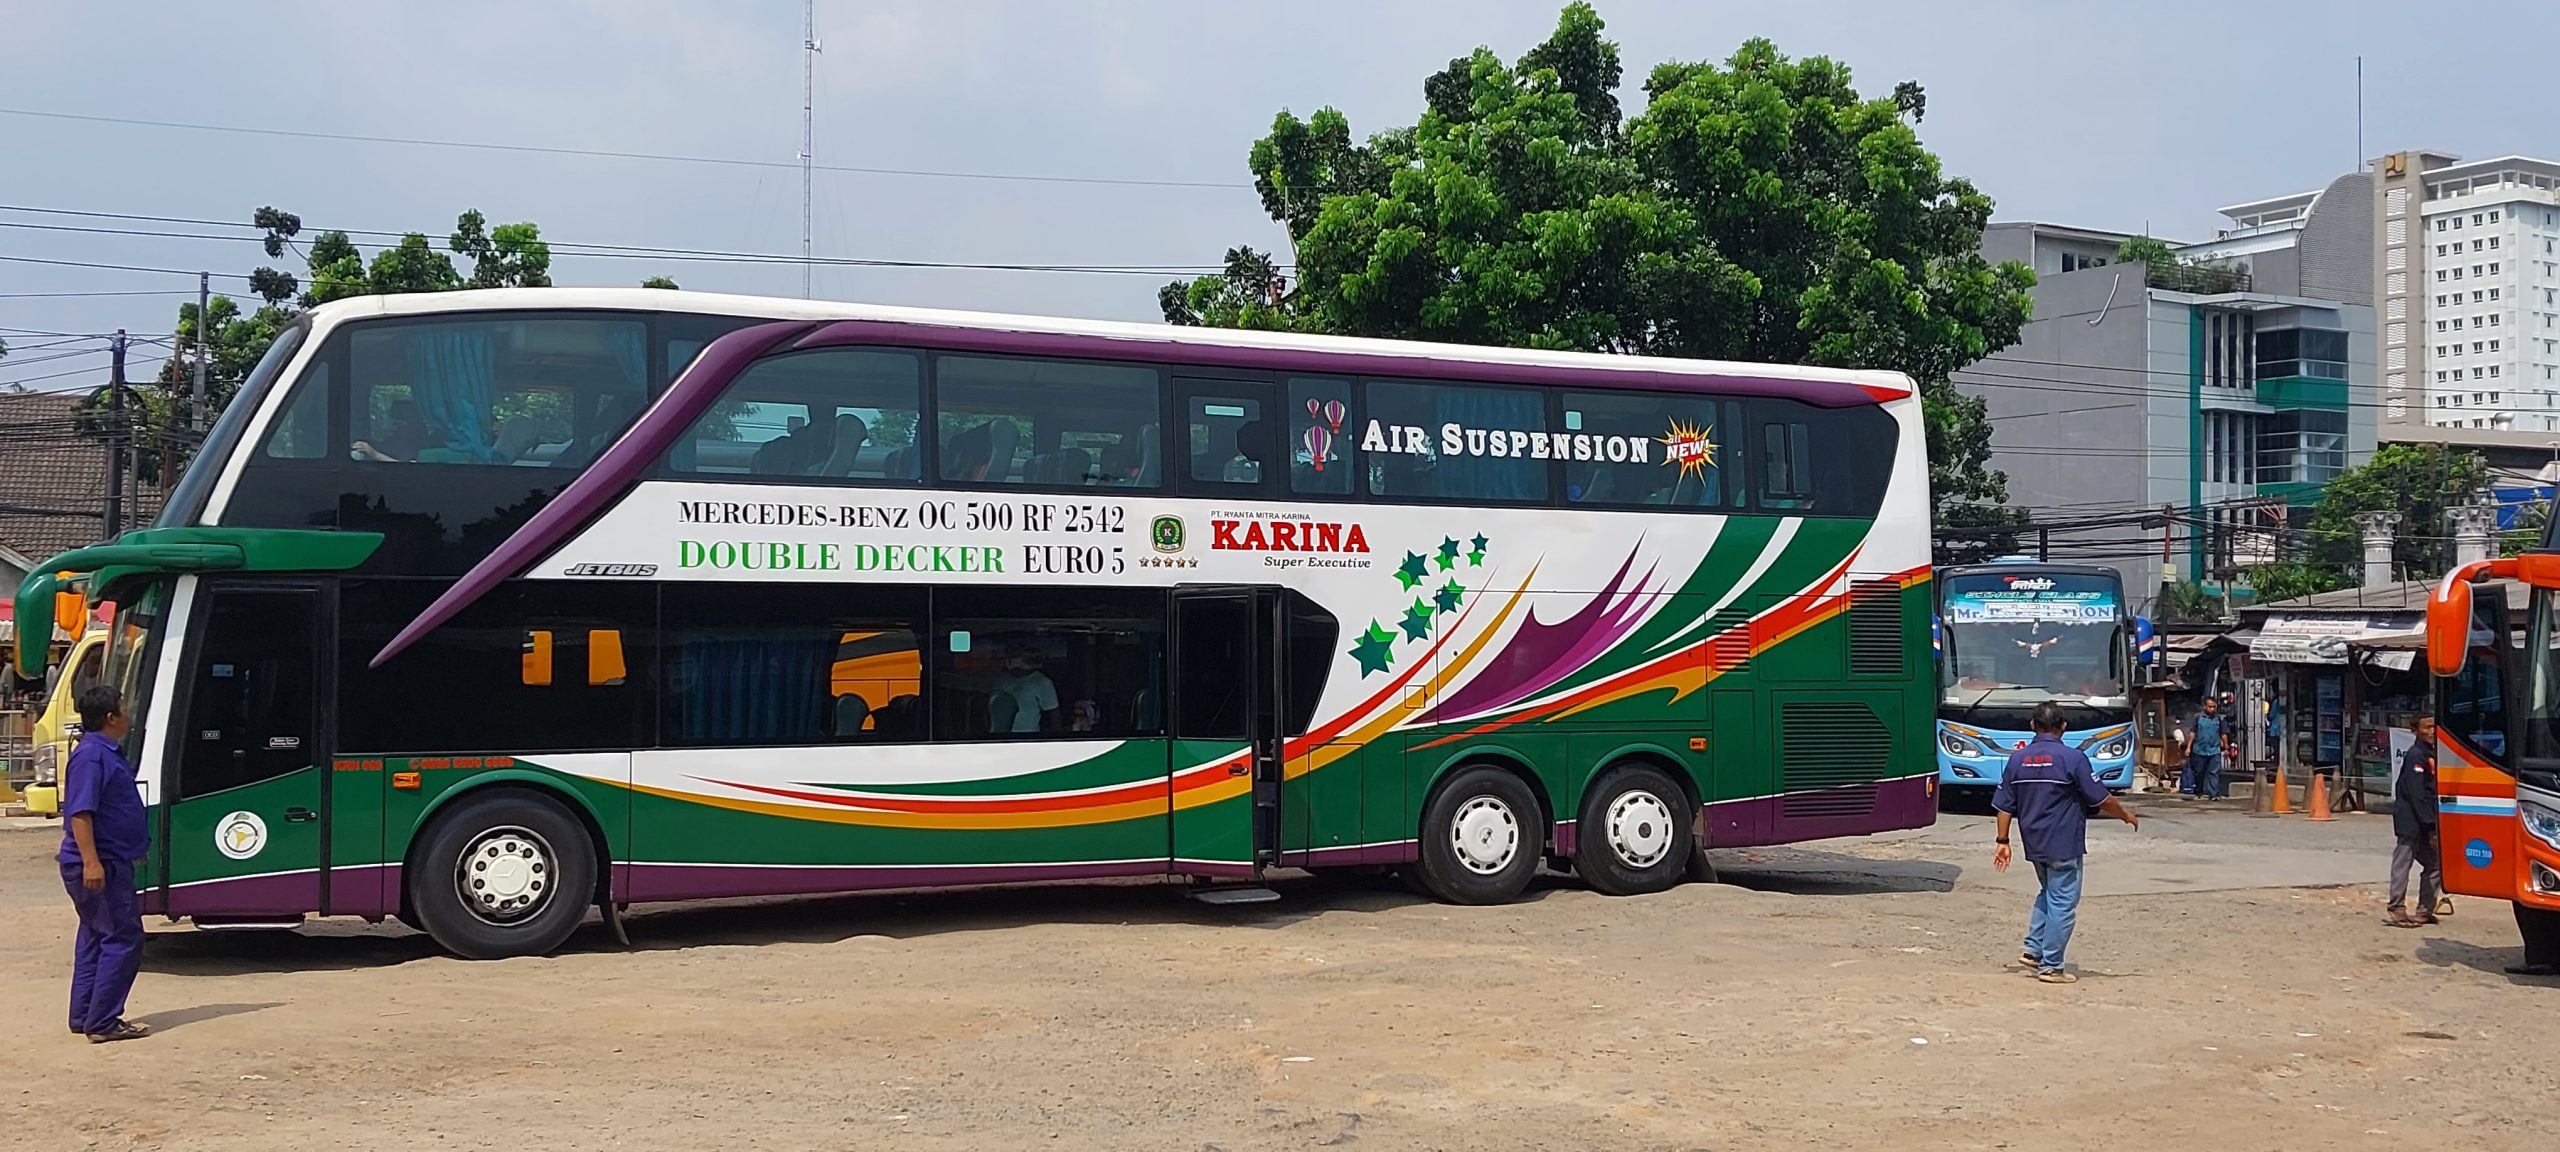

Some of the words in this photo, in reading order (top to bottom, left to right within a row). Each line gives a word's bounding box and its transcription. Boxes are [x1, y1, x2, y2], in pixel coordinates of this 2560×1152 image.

[1666, 439, 1710, 460] NEW!
[678, 501, 909, 528] MERCEDES-BENZ
[918, 501, 956, 530] OC
[966, 502, 1013, 531] 500
[1022, 504, 1056, 532] RF
[1065, 504, 1125, 533] 2542
[1224, 511, 1254, 519] RYANTA
[1256, 512, 1279, 520] MITRA
[1282, 513, 1311, 521] KARINA
[1211, 520, 1370, 553] KARINA
[678, 540, 840, 571] DOUBLE
[854, 544, 1005, 574] DECKER
[1022, 545, 1104, 575] EURO
[1111, 547, 1125, 575] 5
[1264, 556, 1304, 569] Super
[1308, 557, 1371, 568] Executive
[564, 563, 658, 576] JETBUS
[1957, 608, 1984, 619] Mr.
